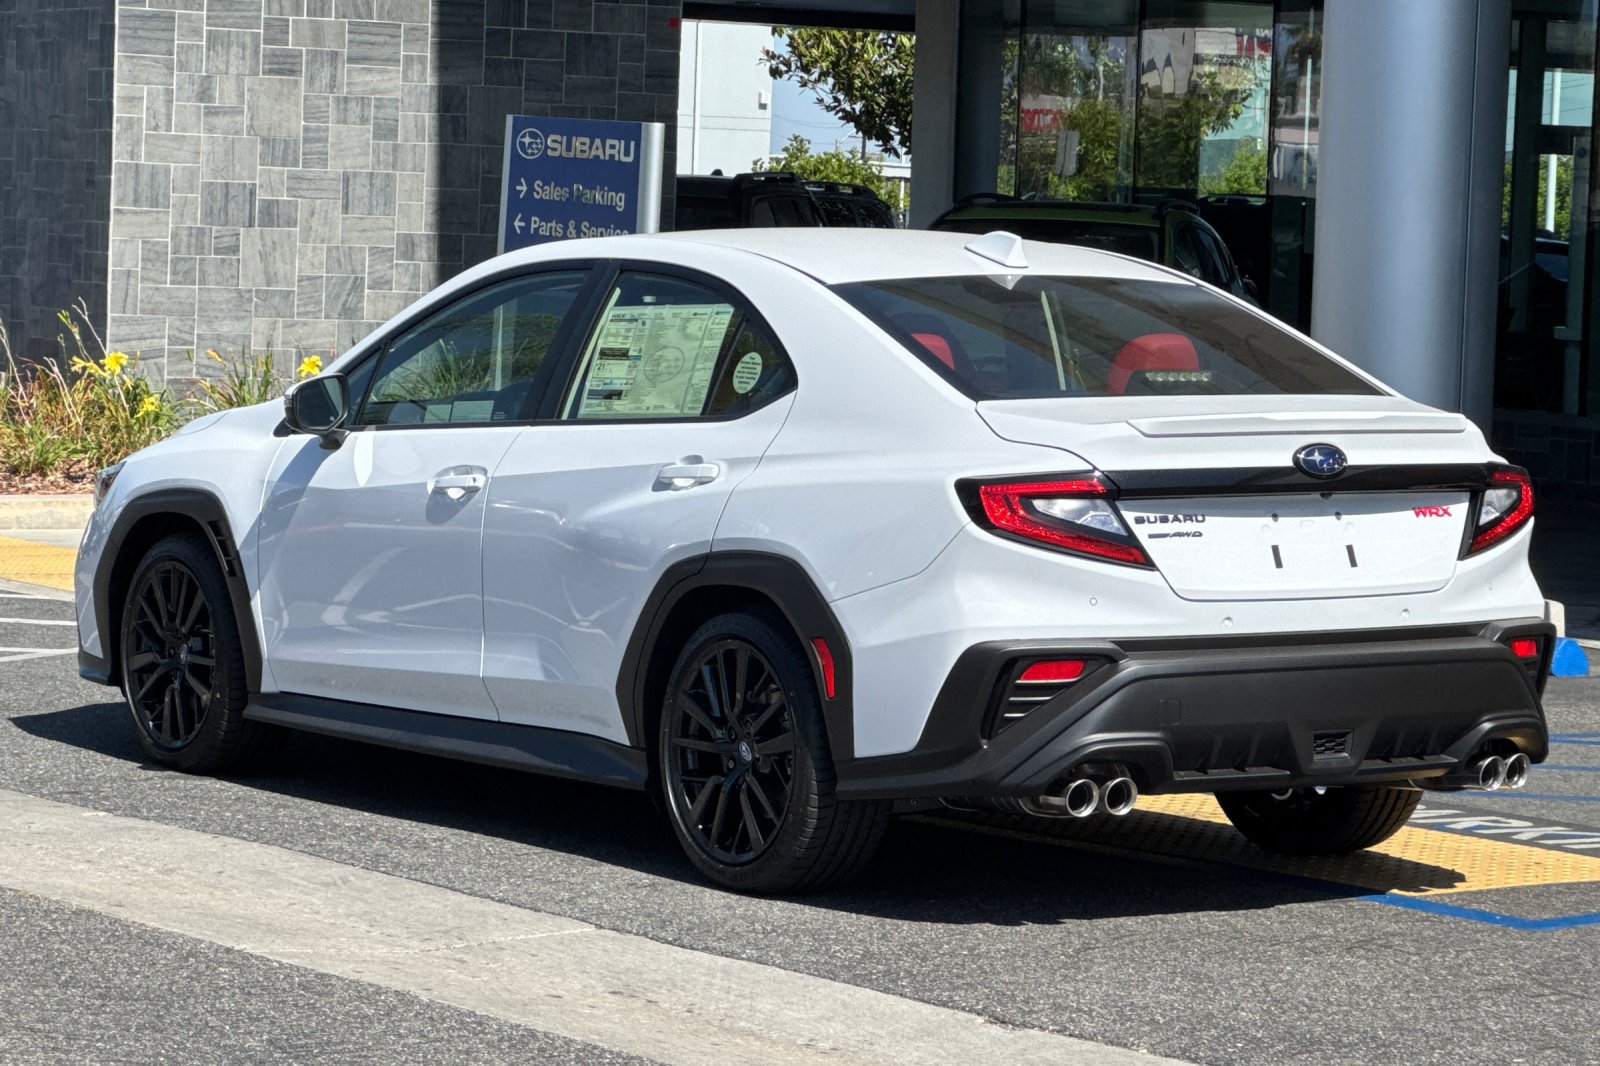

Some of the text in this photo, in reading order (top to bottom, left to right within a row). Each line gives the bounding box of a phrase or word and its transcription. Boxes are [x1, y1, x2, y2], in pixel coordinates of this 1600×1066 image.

[547, 134, 635, 162] SUBARU
[533, 180, 625, 212] Sales Parking
[530, 216, 564, 237] Parts
[567, 220, 577, 238] &
[1134, 514, 1206, 524] SUBARU
[1412, 505, 1452, 517] WRX
